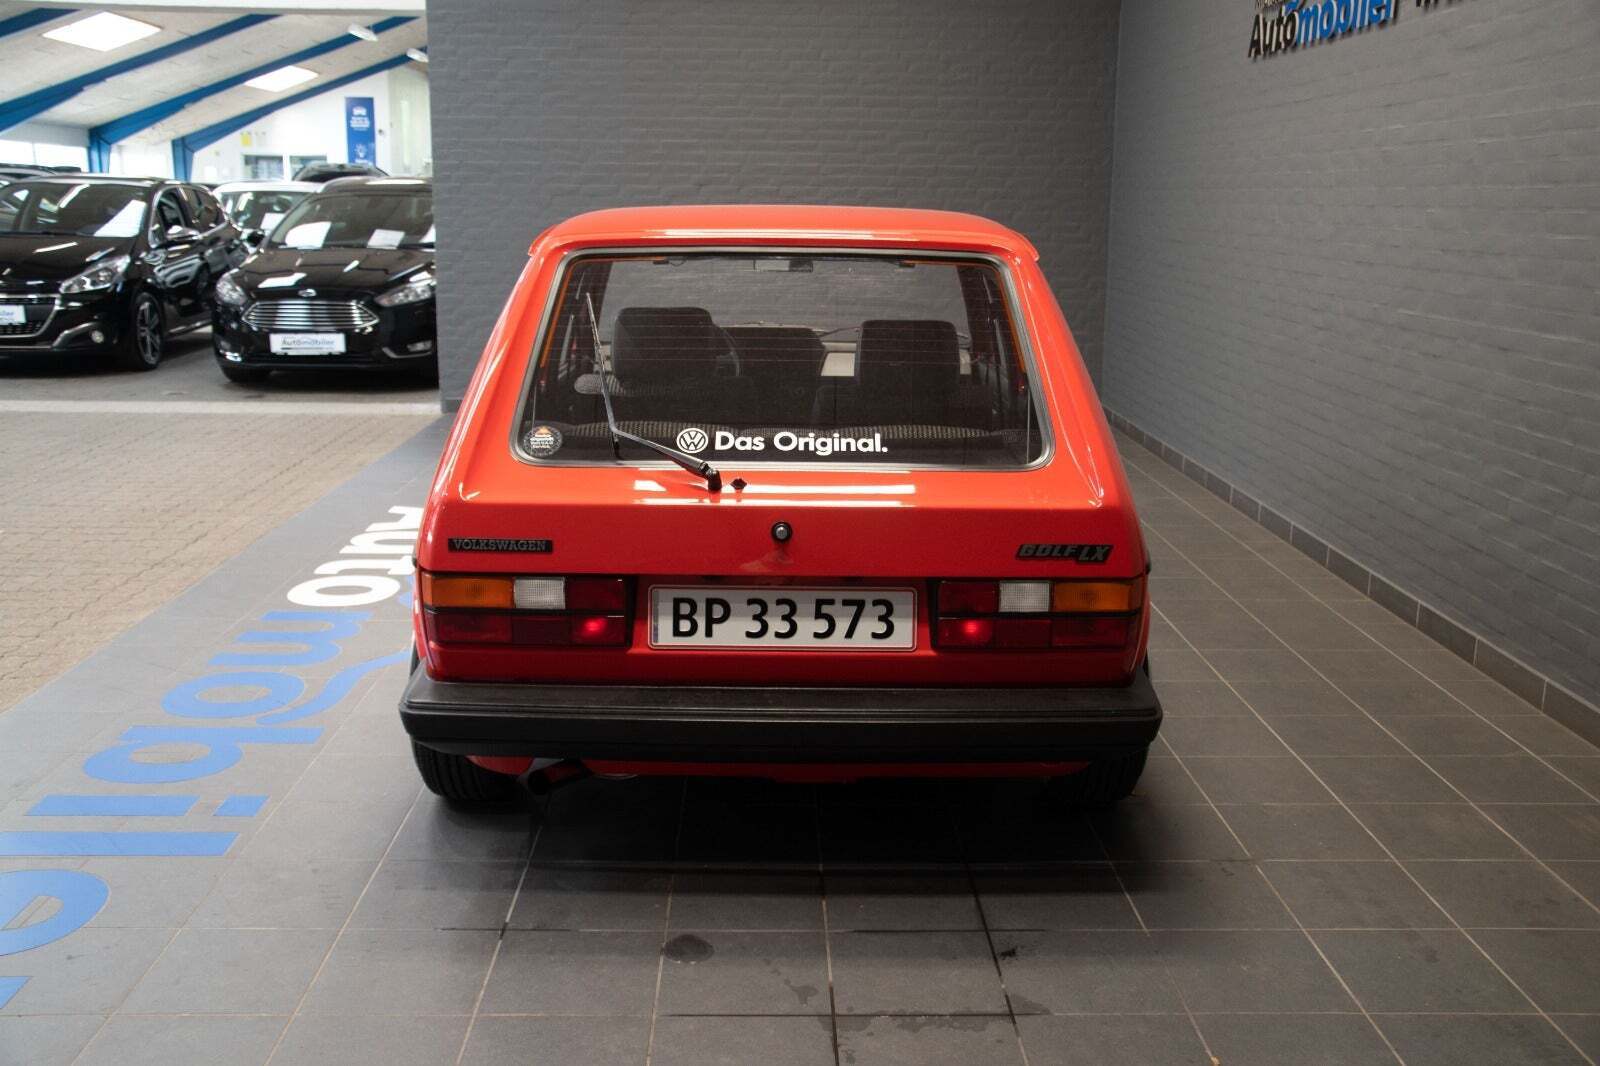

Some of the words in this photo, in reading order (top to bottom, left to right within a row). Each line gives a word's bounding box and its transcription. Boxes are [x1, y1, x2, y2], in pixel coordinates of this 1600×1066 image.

[714, 431, 765, 451] Das
[773, 431, 889, 456] Original.
[454, 539, 546, 551] VOLKSWAGEN
[1018, 544, 1077, 557] GOLF
[672, 597, 731, 638] BP
[745, 598, 798, 639] 33
[813, 599, 895, 639] 573
